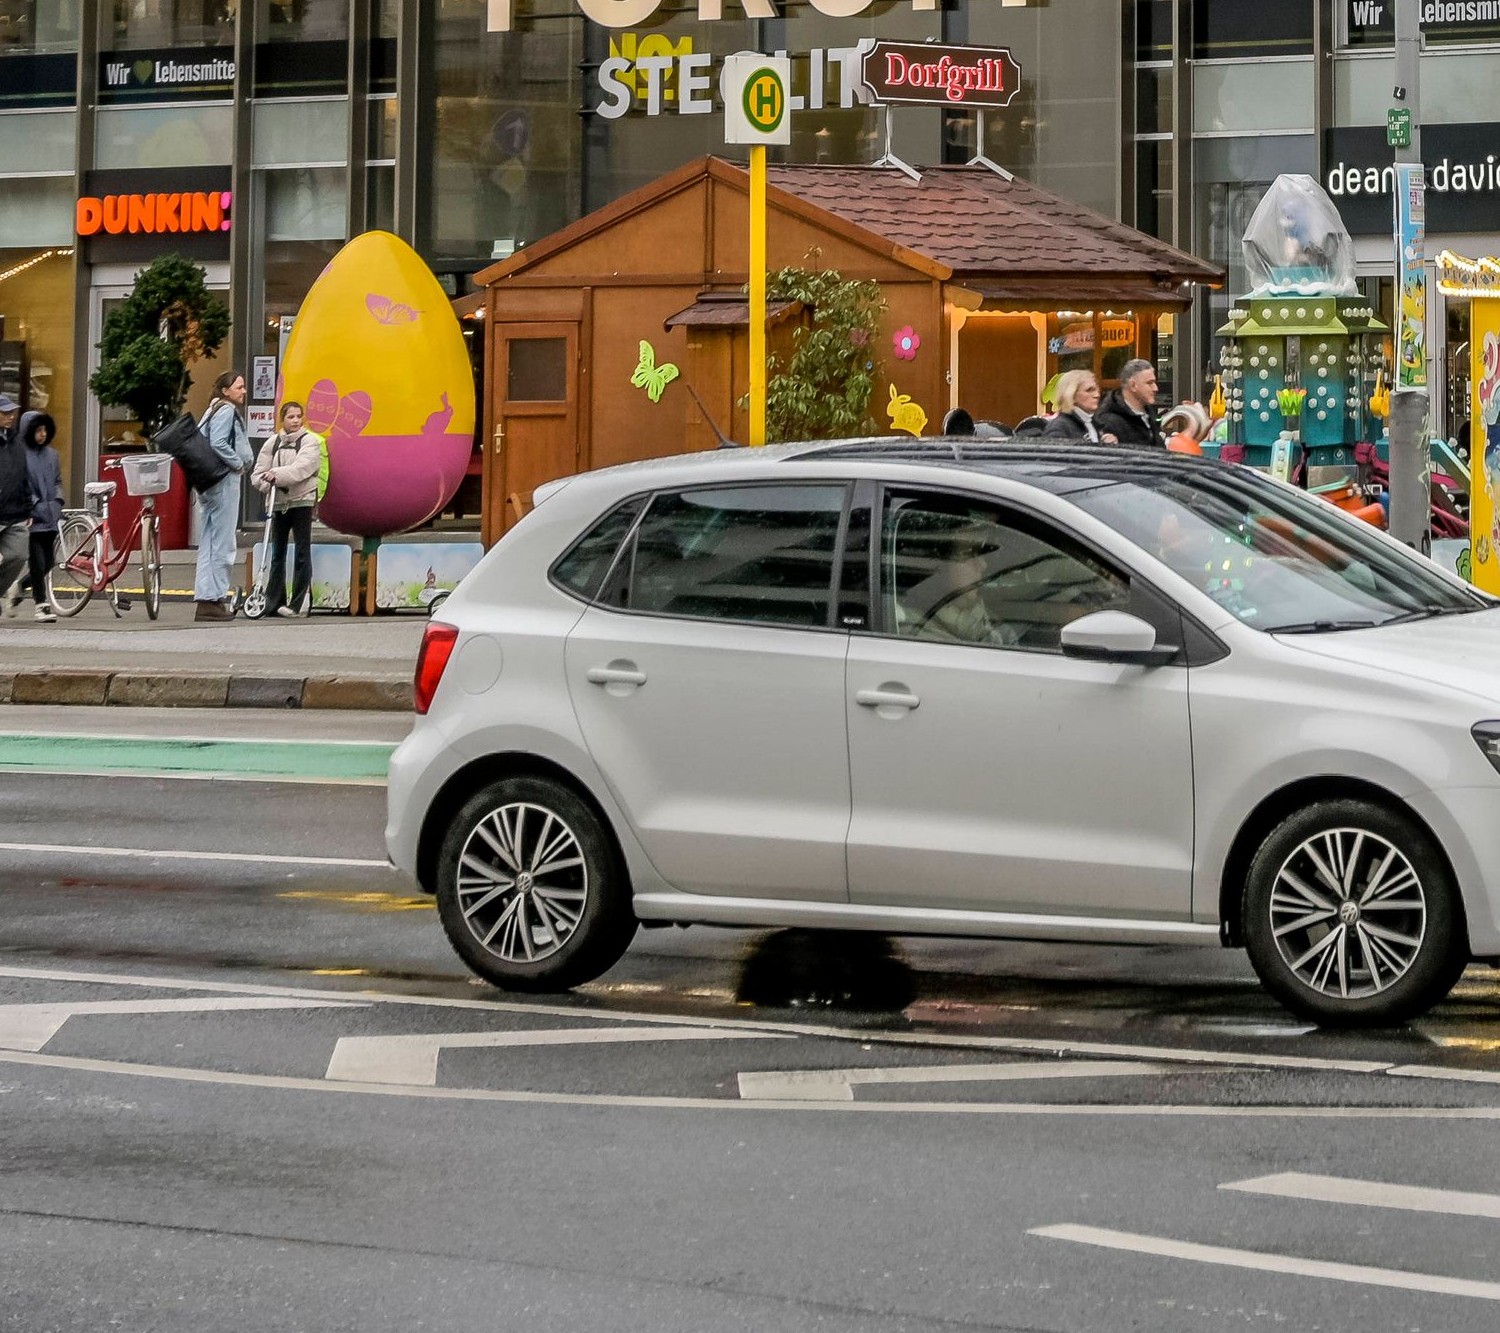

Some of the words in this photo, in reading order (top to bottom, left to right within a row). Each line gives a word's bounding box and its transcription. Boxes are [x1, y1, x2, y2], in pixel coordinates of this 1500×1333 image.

[1352, 0, 1383, 26] Wir
[107, 63, 131, 85] Wir
[155, 59, 236, 83] Lebensmitte
[884, 51, 1004, 102] Dorfgrill
[1102, 327, 1131, 341] auer
[249, 411, 266, 421] WIR
